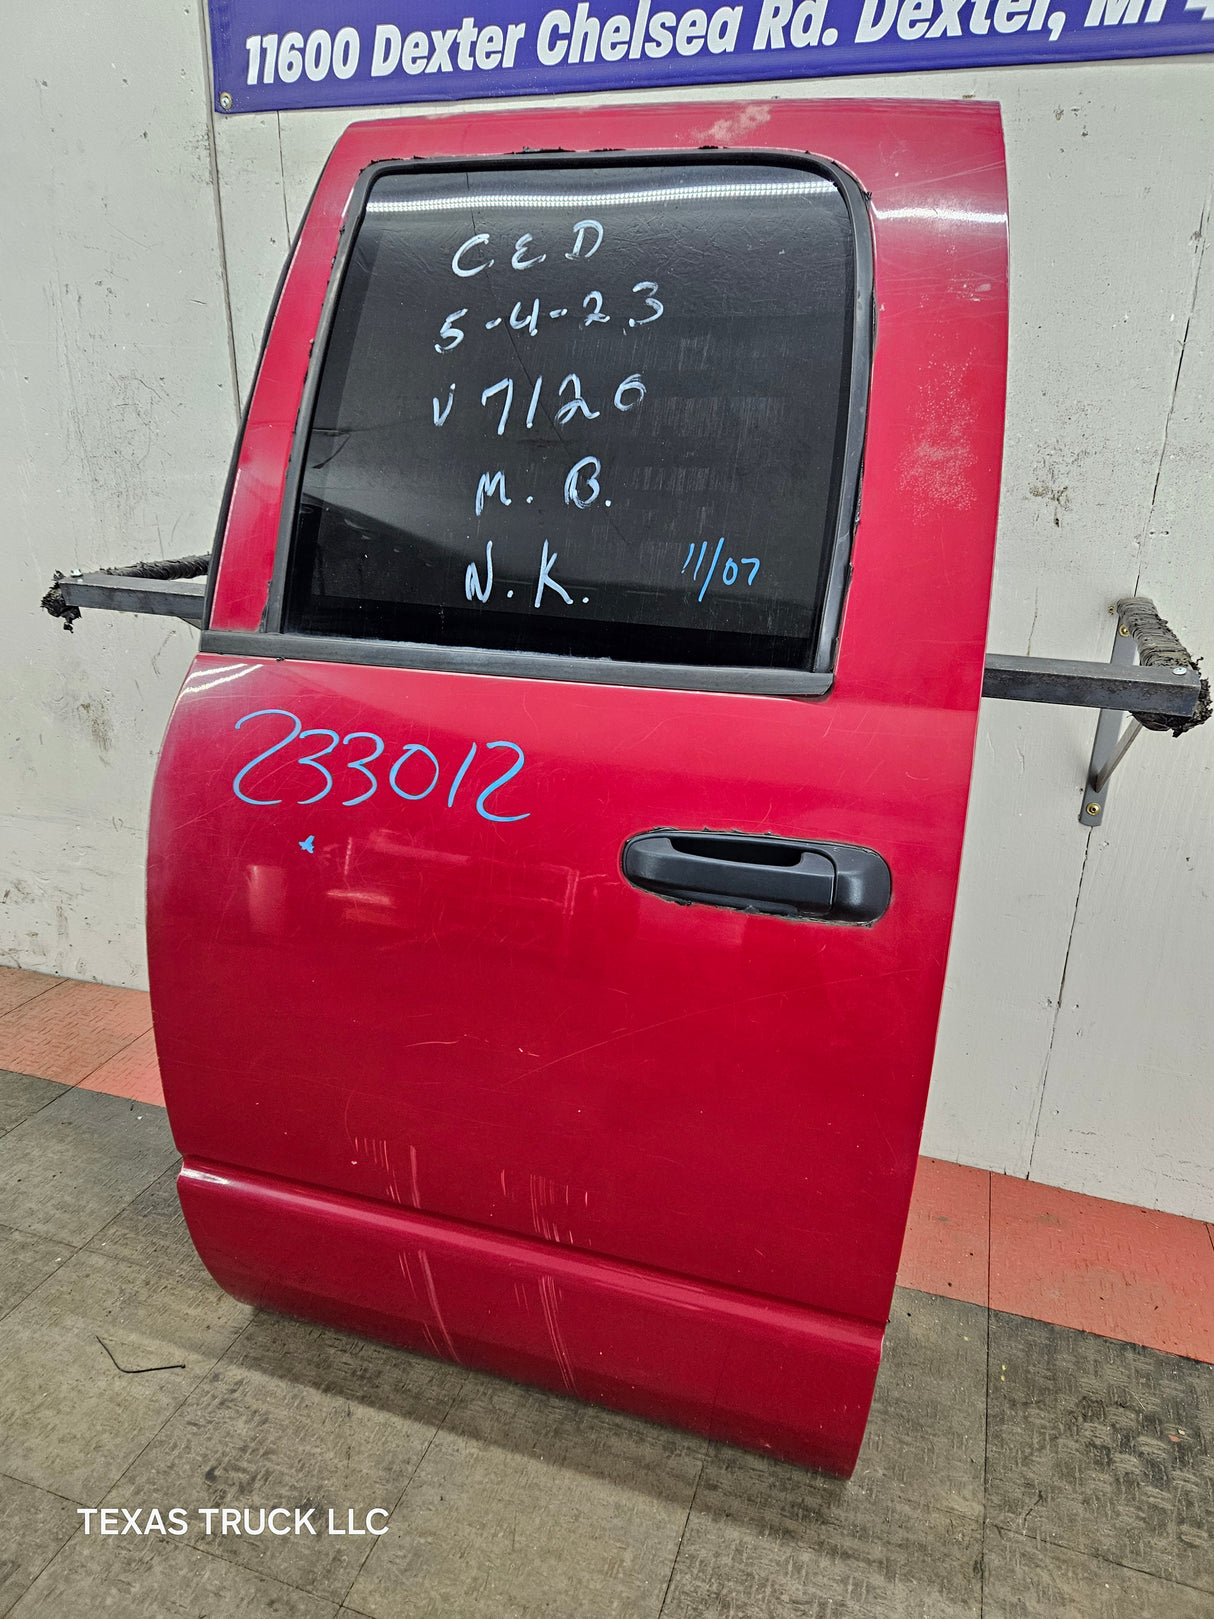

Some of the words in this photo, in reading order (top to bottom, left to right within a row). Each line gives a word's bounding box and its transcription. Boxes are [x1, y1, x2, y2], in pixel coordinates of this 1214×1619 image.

[245, 27, 361, 85] 11600
[370, 17, 526, 77] Dexter
[537, 0, 744, 66] Chelsea
[752, 0, 839, 51] Rd.
[681, 537, 761, 602] 11/07
[233, 709, 531, 822] 233012
